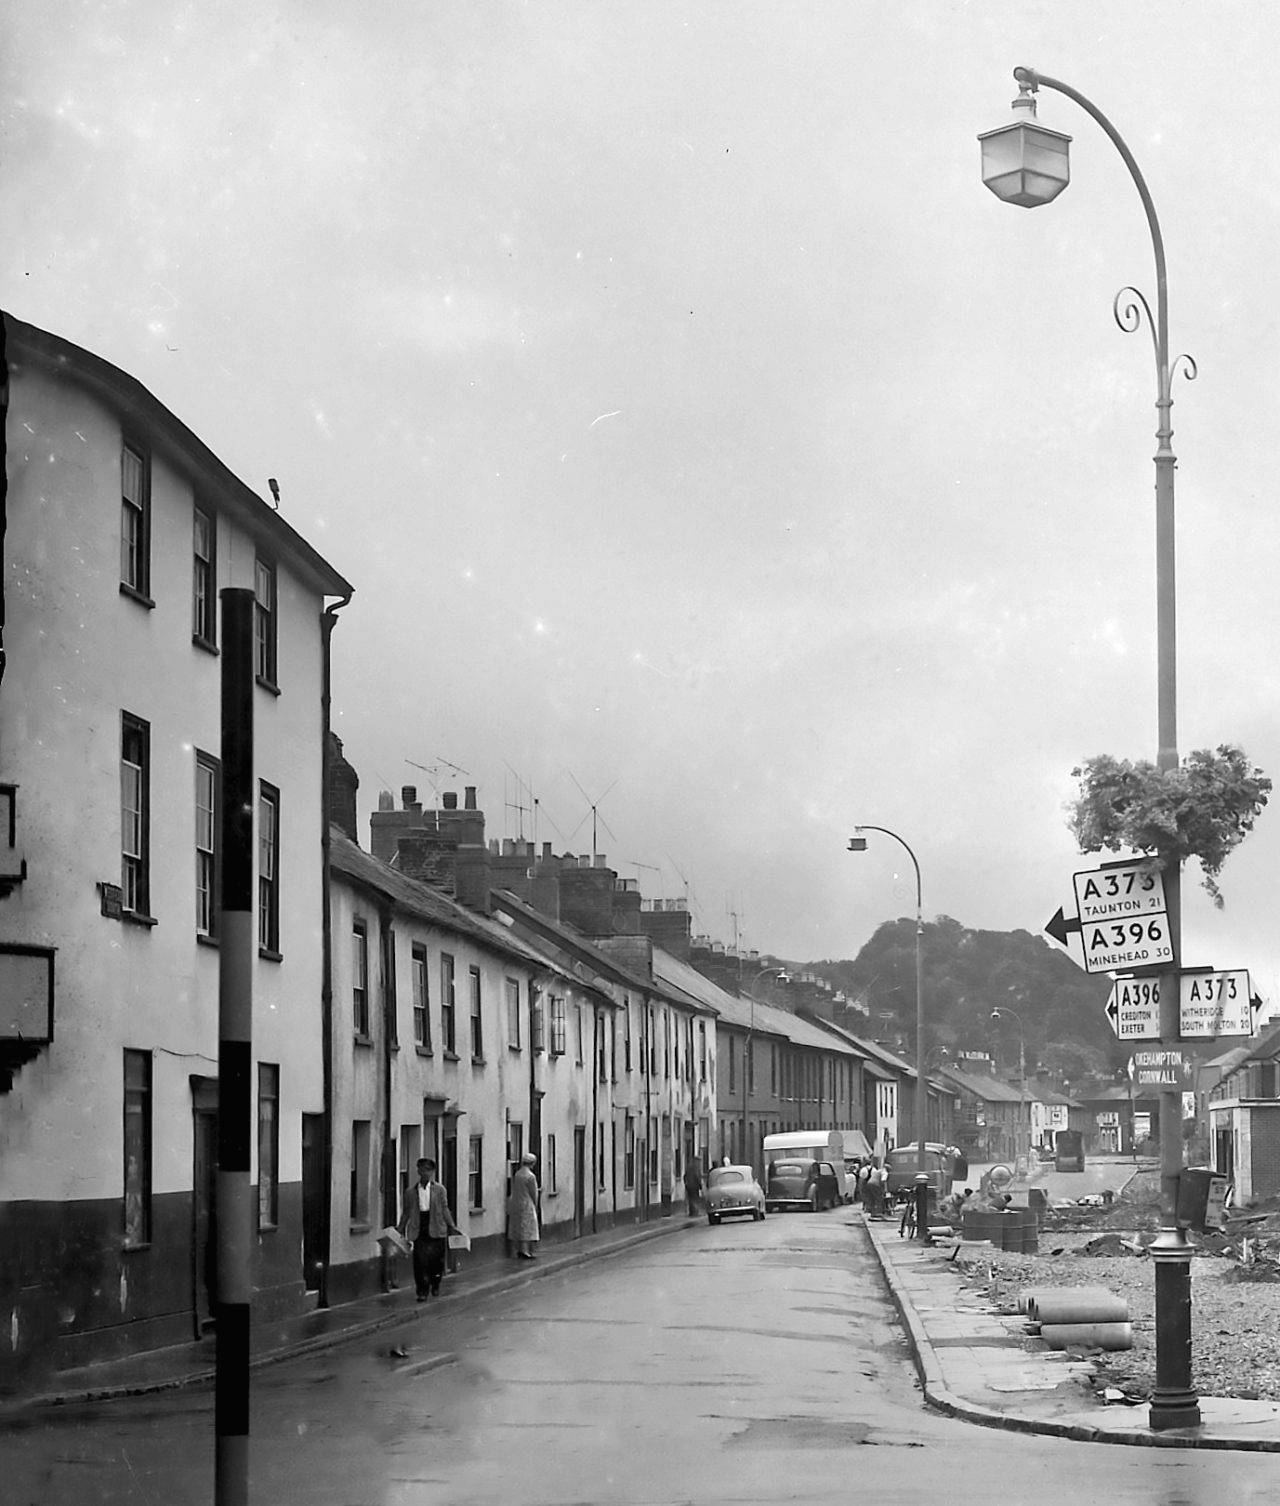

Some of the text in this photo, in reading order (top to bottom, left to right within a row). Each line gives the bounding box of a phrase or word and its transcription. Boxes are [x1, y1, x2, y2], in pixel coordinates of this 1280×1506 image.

[1083, 871, 1155, 900] A373
[1084, 897, 1161, 916] TAUNTON 21
[1091, 919, 1162, 951] A396
[1089, 946, 1170, 967] MINEHEAD 30
[1121, 983, 1160, 1006] A396
[1190, 978, 1237, 1001] A373
[1121, 1010, 1151, 1021] CREDITON
[1181, 1019, 1250, 1031] SOUTH MOLTON 20
[1121, 1023, 1145, 1034] EXETER
[1135, 1051, 1182, 1066] OKEHAMPTON
[1138, 1069, 1178, 1084] CORNWALL
